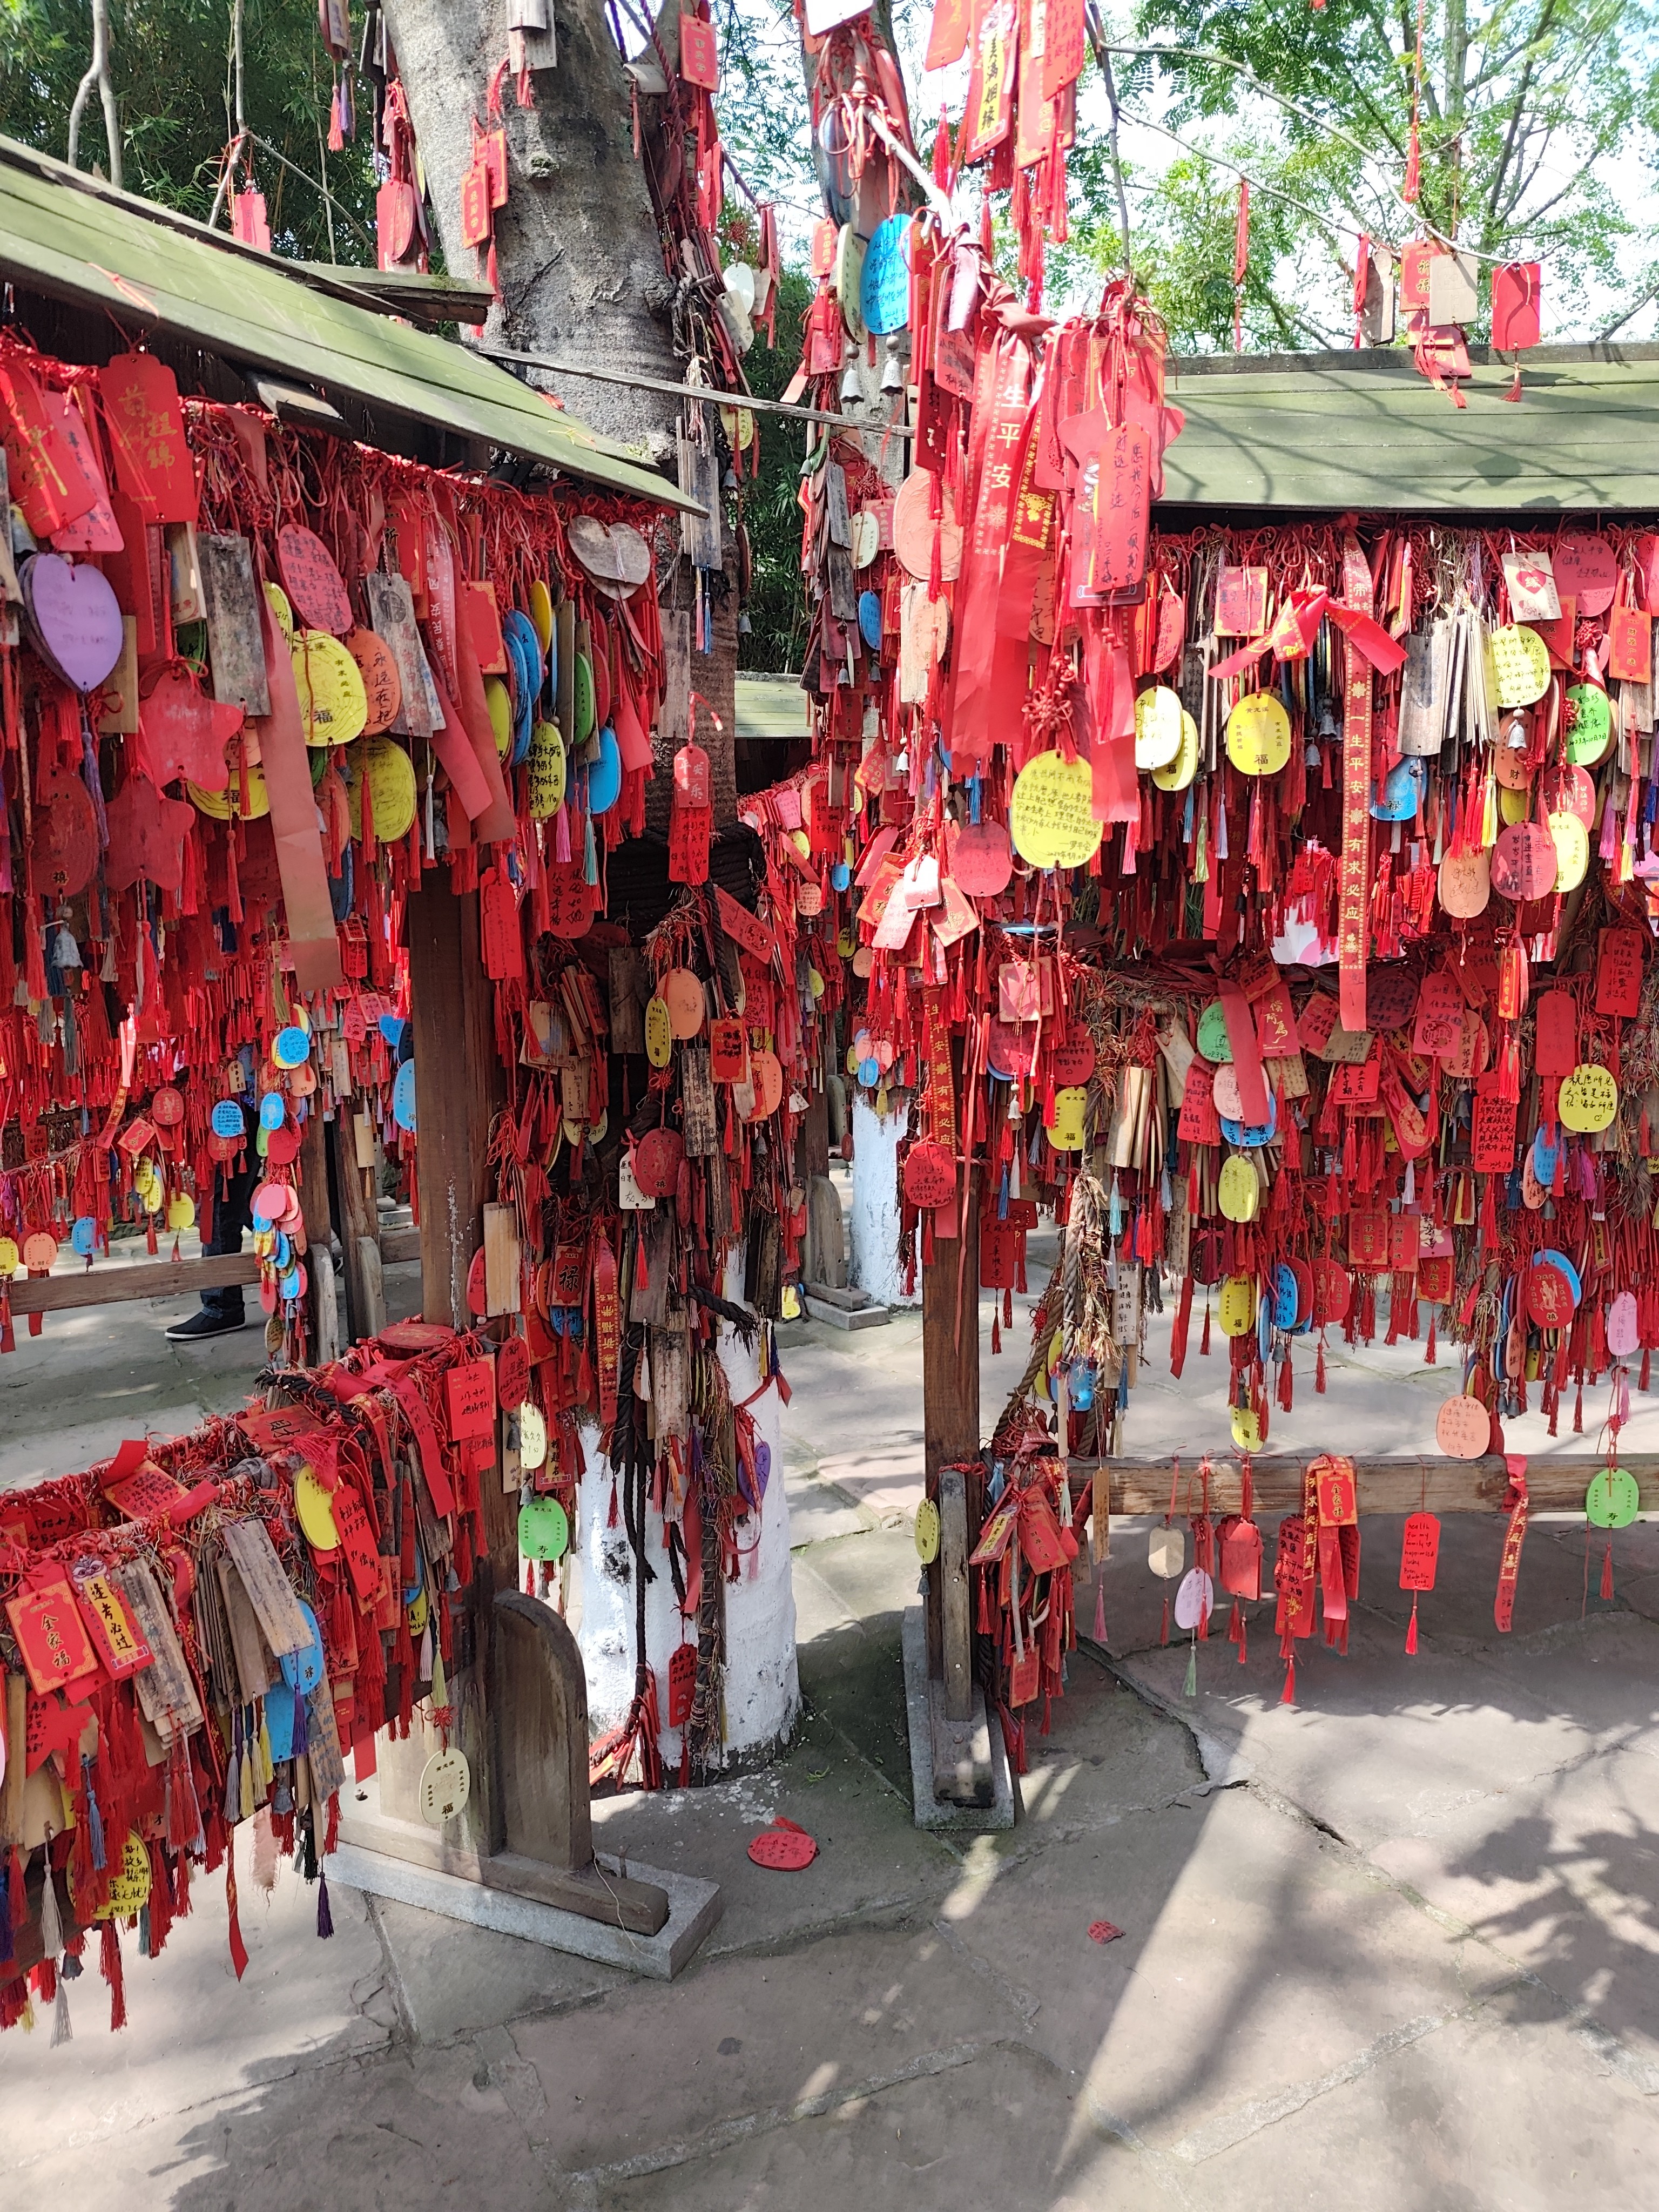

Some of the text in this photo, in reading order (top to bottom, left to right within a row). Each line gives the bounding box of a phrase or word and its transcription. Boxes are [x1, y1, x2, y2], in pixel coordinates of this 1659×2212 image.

[981, 33, 999, 130] 美满姻缘
[990, 353, 1028, 490] 一生平安
[1347, 549, 1367, 597] 祈福带
[1525, 576, 1541, 589] 缘
[1353, 602, 1369, 611] 姓名
[335, 659, 352, 698] 有求必应
[314, 709, 333, 725] 福
[1246, 706, 1269, 714] 黄龙溪
[1236, 725, 1244, 750] 菩提祈福
[1274, 721, 1283, 747] 有求必应
[1254, 754, 1269, 765] 福
[1349, 716, 1366, 794] 一生平安
[1509, 769, 1520, 780] 财
[1387, 801, 1402, 811] 禄
[1344, 838, 1364, 921] 有求必应
[928, 988, 946, 1053] 一生平安
[937, 1085, 952, 1145] 有求必应
[1064, 1132, 1076, 1141] 福
[1364, 1224, 1375, 1253] 求财符
[558, 1264, 580, 1293] 禄
[1233, 1318, 1243, 1328] 福
[1241, 1428, 1251, 1439] 福
[1331, 1483, 1344, 1518] 全家福
[1606, 1512, 1618, 1521] 寿
[536, 1545, 549, 1554] 寿
[91, 1583, 133, 1651] 逢考必过
[41, 1614, 71, 1669] 全家福
[435, 1760, 455, 1772] 黄龙溪
[442, 1802, 454, 1815] 福
